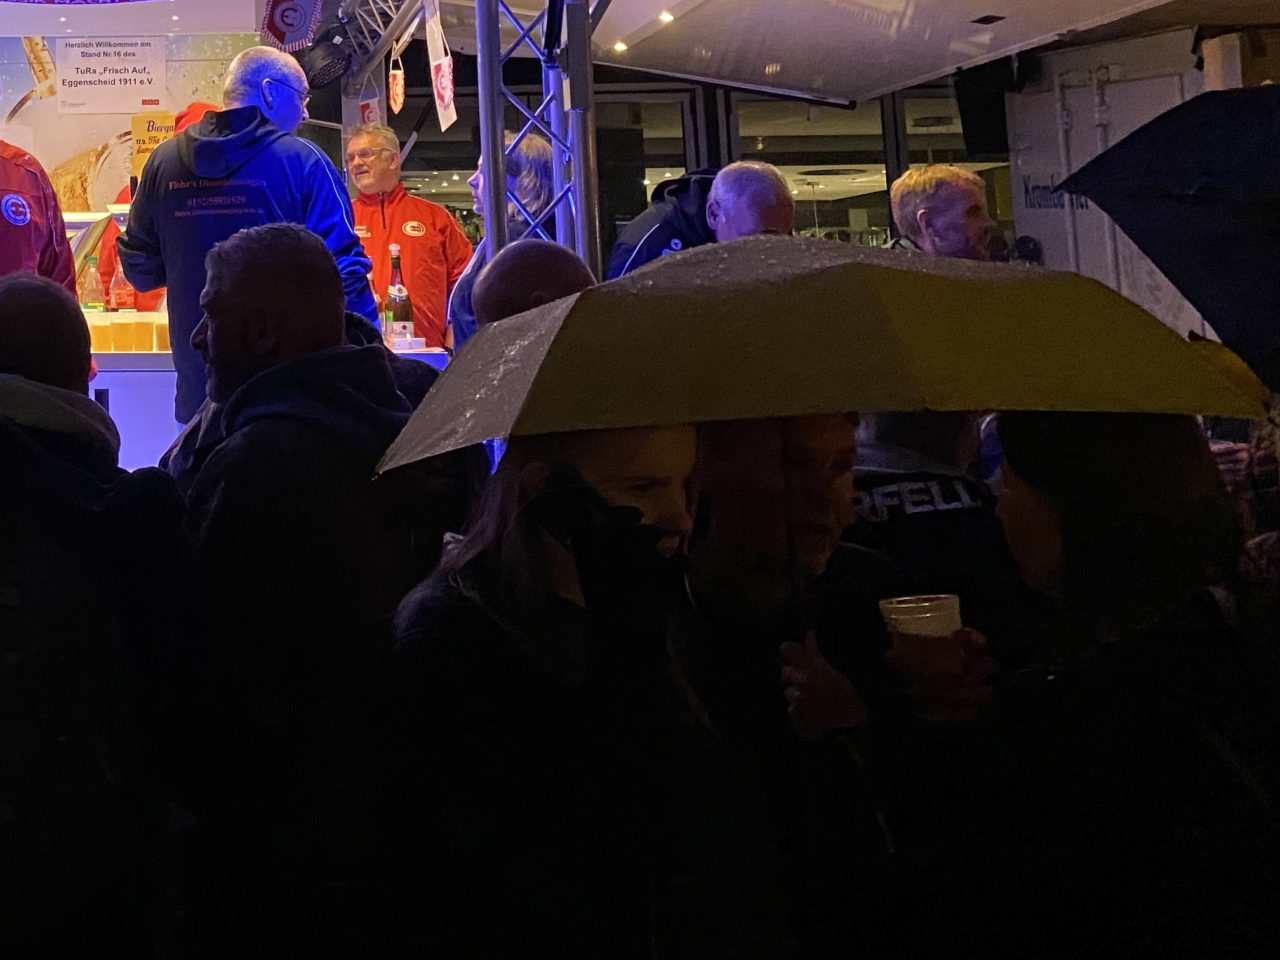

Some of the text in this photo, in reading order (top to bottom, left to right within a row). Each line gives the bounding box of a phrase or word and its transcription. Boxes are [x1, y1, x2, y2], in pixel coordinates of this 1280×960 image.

[65, 41, 94, 49] Herzlich
[75, 67, 97, 75] TuRa
[61, 78, 116, 88] Eggenscheid
[118, 78, 137, 86] 1911
